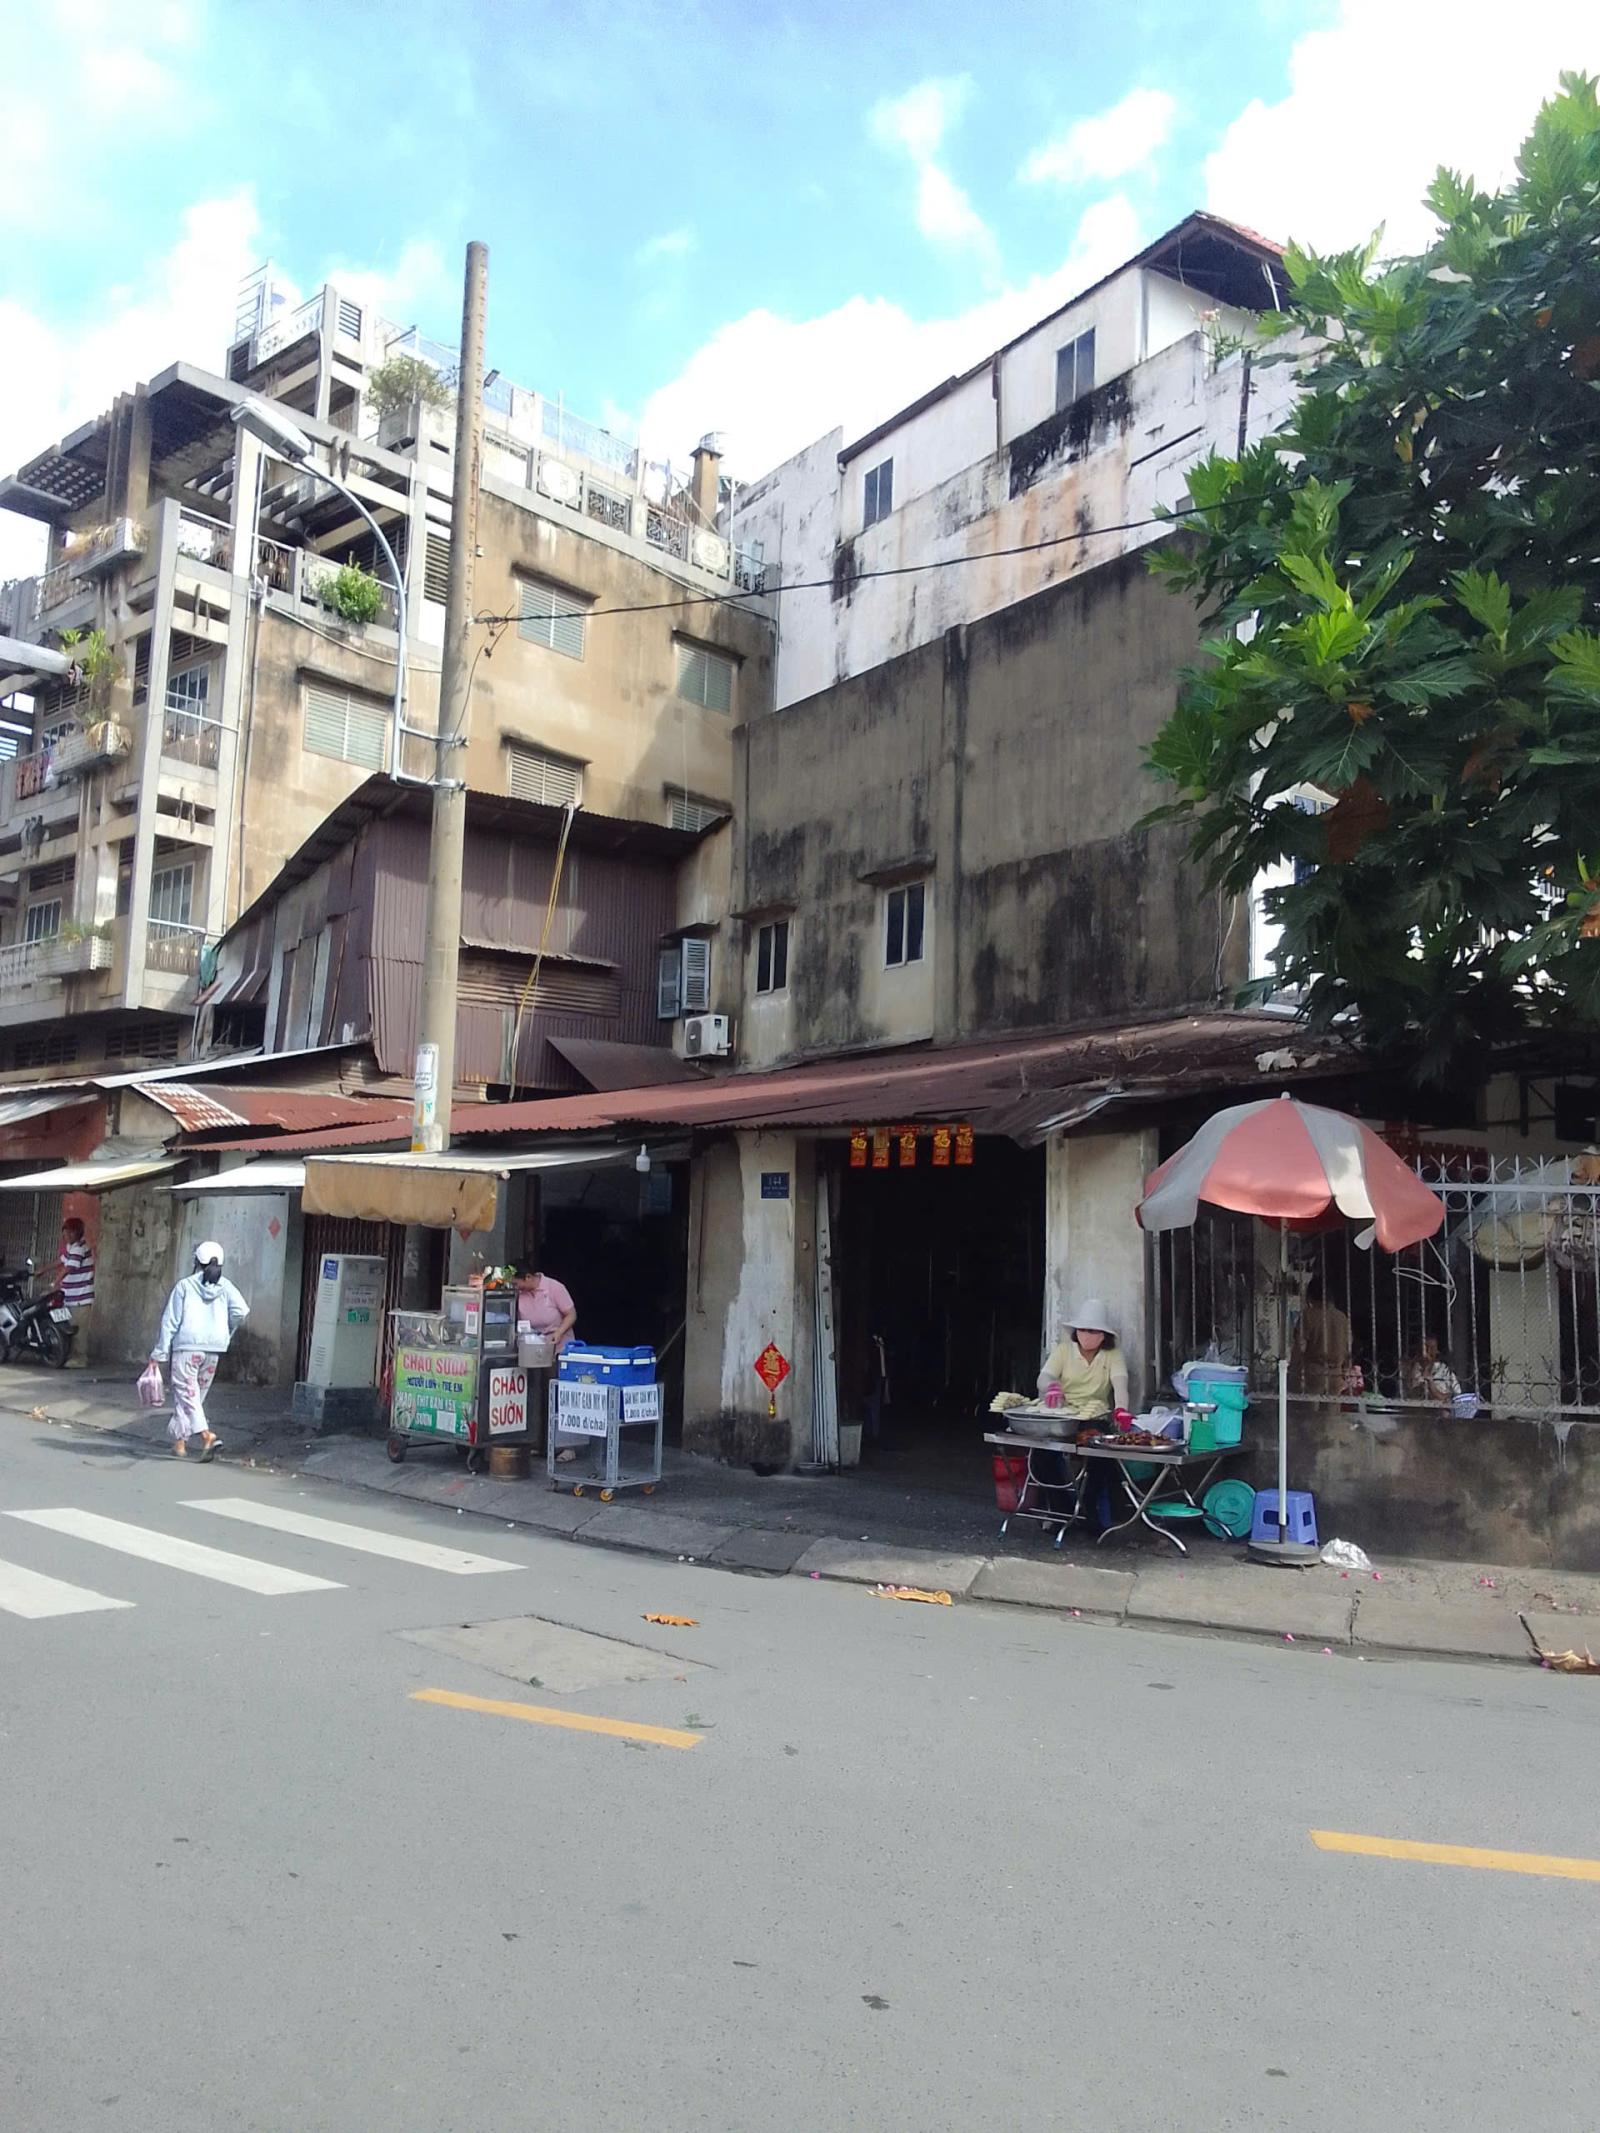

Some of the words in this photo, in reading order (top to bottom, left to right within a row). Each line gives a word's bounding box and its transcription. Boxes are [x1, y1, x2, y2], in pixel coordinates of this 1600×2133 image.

[492, 1369, 525, 1396] CHÁO
[490, 1400, 523, 1427] SƯỜN
[560, 1413, 581, 1428] 7.000
